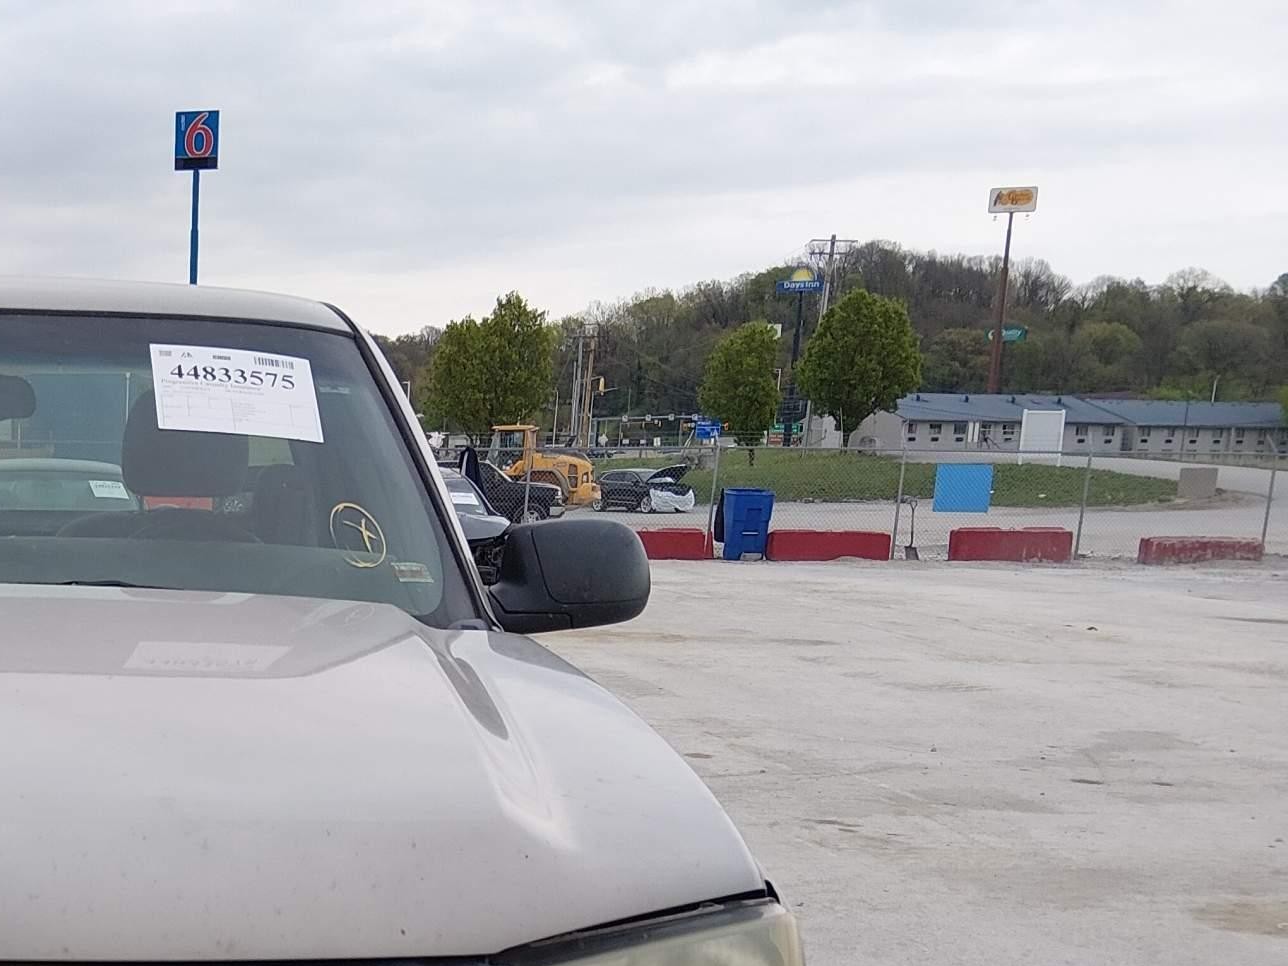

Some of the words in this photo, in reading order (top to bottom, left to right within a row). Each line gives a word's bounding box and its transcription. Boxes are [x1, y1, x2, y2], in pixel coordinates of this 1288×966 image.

[184, 112, 214, 158] 6
[783, 281, 804, 289] Days
[170, 363, 296, 390] 44833575
